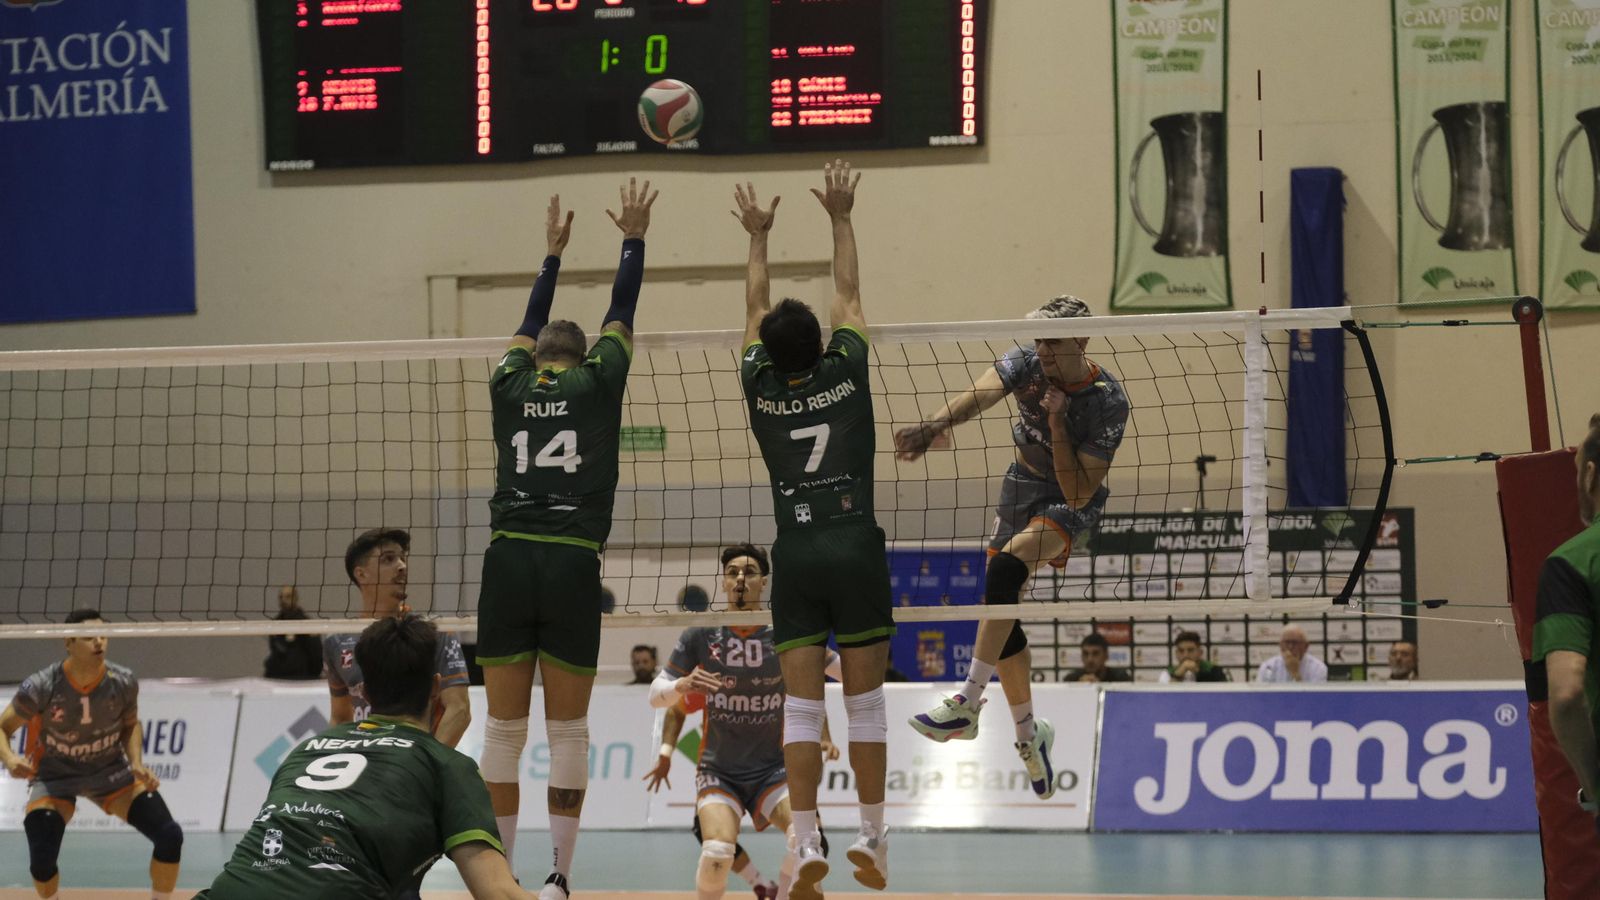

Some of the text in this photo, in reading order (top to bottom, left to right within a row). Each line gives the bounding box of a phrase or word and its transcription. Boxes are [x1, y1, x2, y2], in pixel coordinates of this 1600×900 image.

[644, 34, 667, 74] 0
[0, 67, 169, 121] LMERÍA
[523, 400, 568, 418] RUIZ
[756, 378, 856, 415] PAULO RENAN
[511, 430, 583, 474] 14
[789, 422, 830, 473] 7
[1154, 535, 1245, 551] MASCULIN
[726, 637, 763, 668] 20
[79, 696, 92, 725] 1
[295, 753, 367, 791] 9
